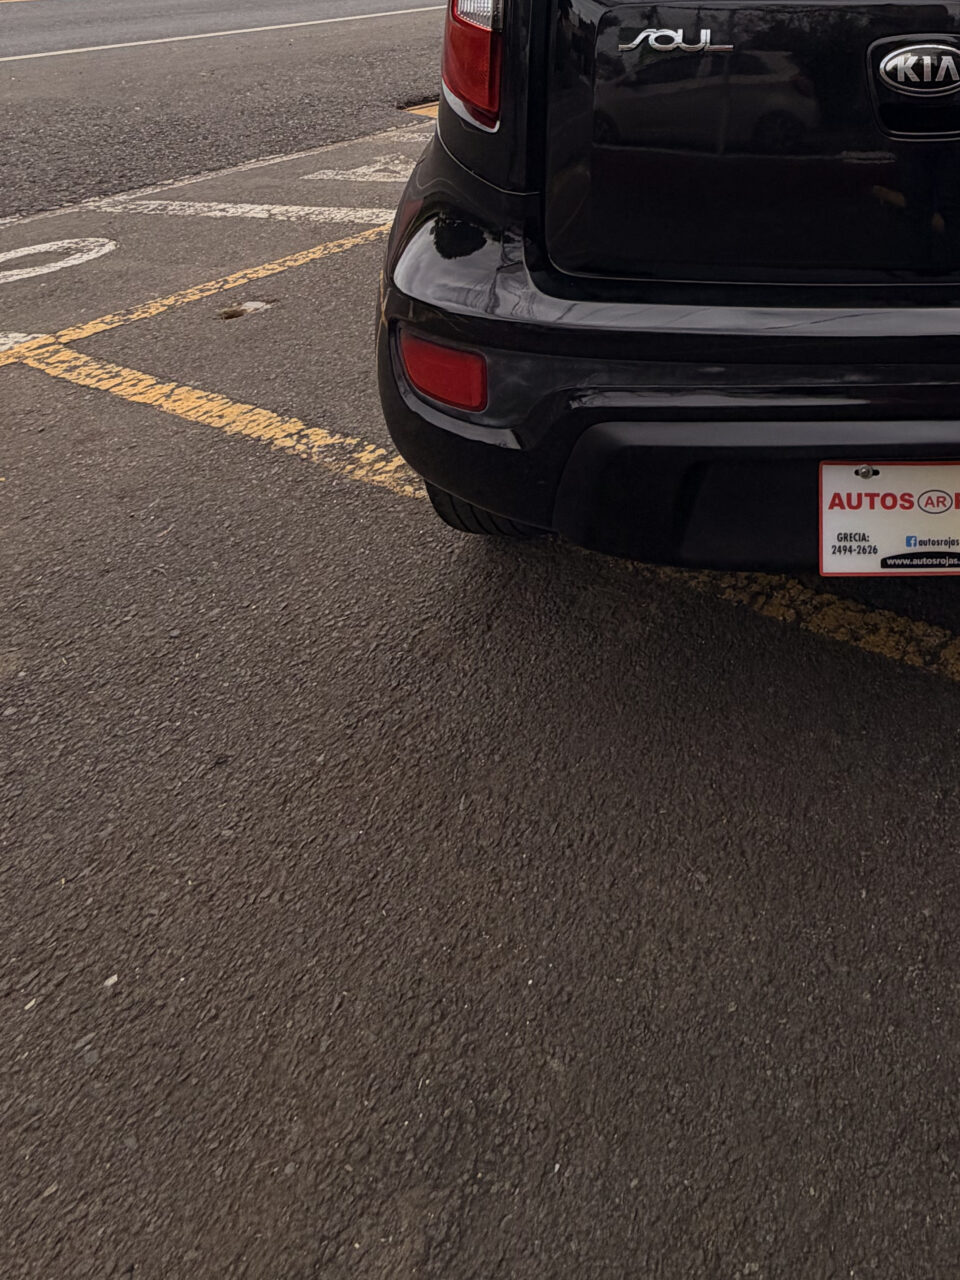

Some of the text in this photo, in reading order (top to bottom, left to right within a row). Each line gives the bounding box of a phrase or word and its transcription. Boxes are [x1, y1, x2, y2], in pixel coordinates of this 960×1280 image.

[618, 29, 734, 52] SOUL
[897, 55, 960, 83] KIA
[828, 492, 915, 510] AUTOS
[924, 497, 947, 508] AR
[836, 532, 870, 543] GRECIA:
[918, 537, 960, 548] autosrojas
[831, 545, 878, 555] 2494-2626
